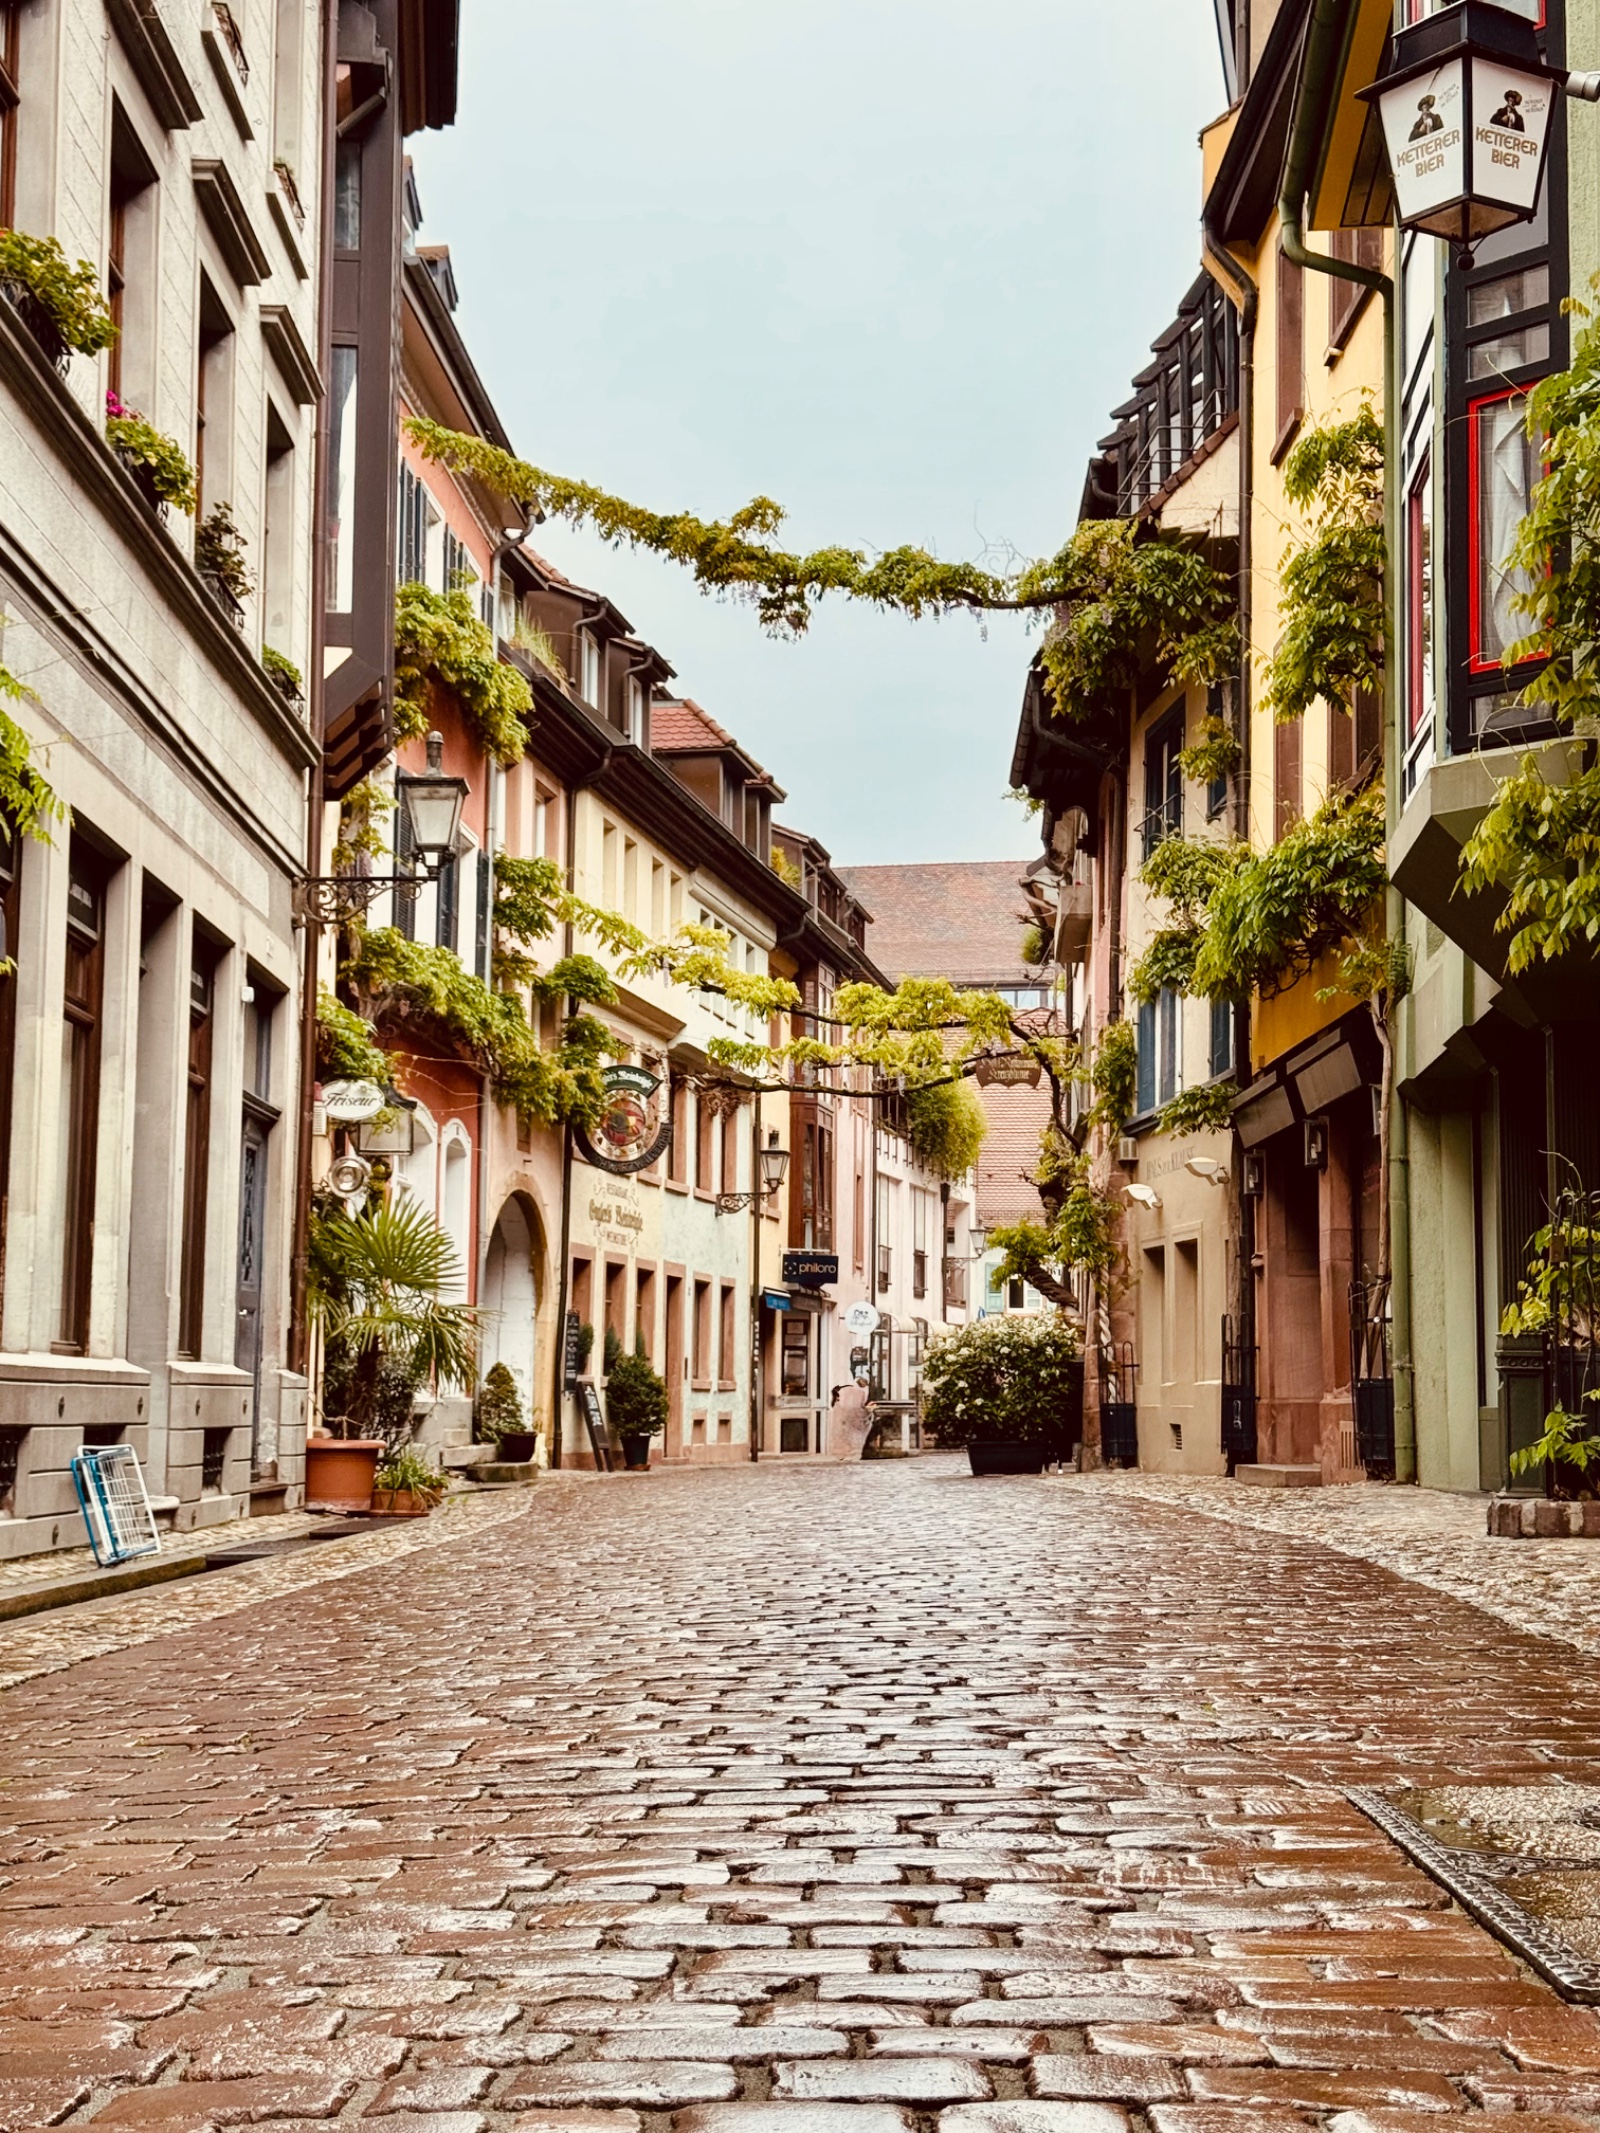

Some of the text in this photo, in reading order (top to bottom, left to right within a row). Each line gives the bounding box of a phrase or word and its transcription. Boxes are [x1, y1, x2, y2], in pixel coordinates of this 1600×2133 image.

[1396, 128, 1460, 168] KETTERER
[1475, 126, 1538, 157] KETTERER
[1415, 153, 1445, 178] BIER
[1490, 148, 1520, 170] BIER
[326, 1092, 377, 1107] Friseur
[799, 1263, 837, 1275] philoro
